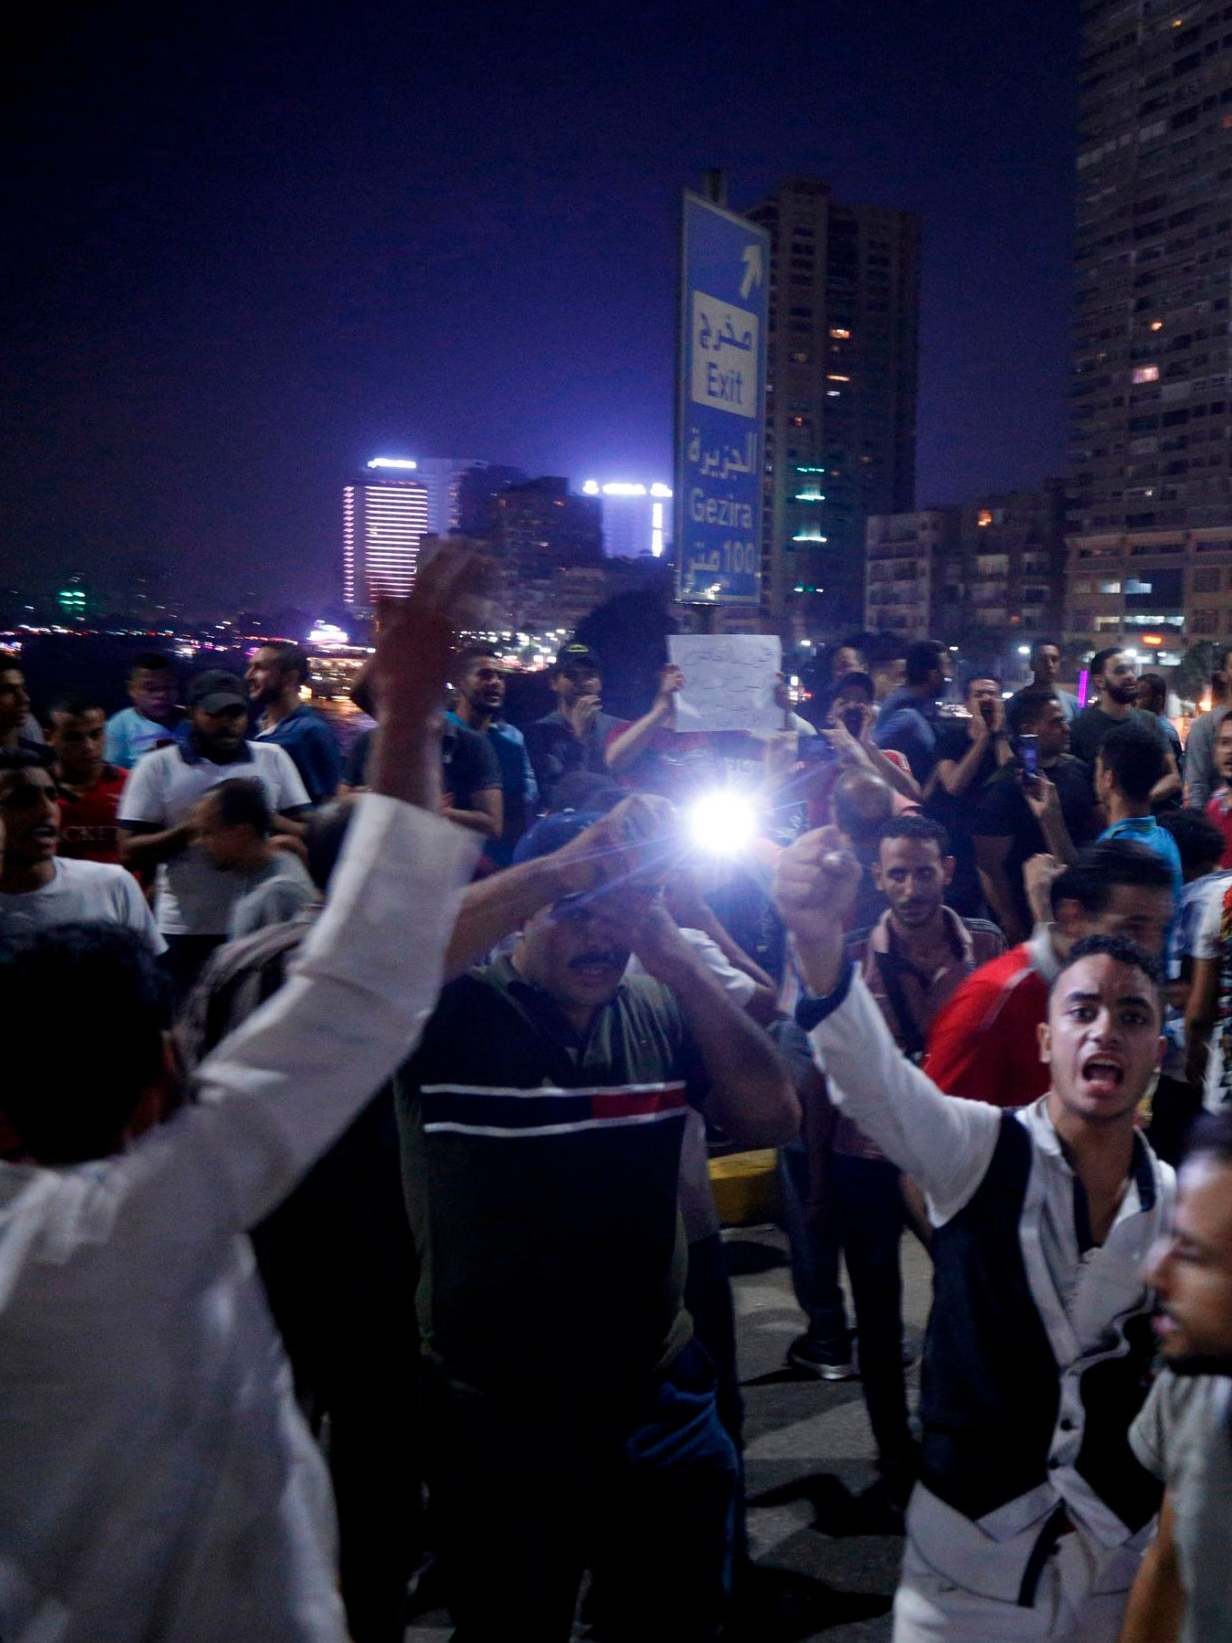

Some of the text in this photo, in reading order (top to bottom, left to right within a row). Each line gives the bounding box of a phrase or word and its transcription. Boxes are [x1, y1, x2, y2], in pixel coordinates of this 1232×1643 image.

[699, 312, 752, 351] مخرج
[706, 361, 742, 404] Exit
[687, 426, 758, 481] الجزيرة
[690, 487, 753, 530] Gezira
[723, 539, 756, 574] 100
